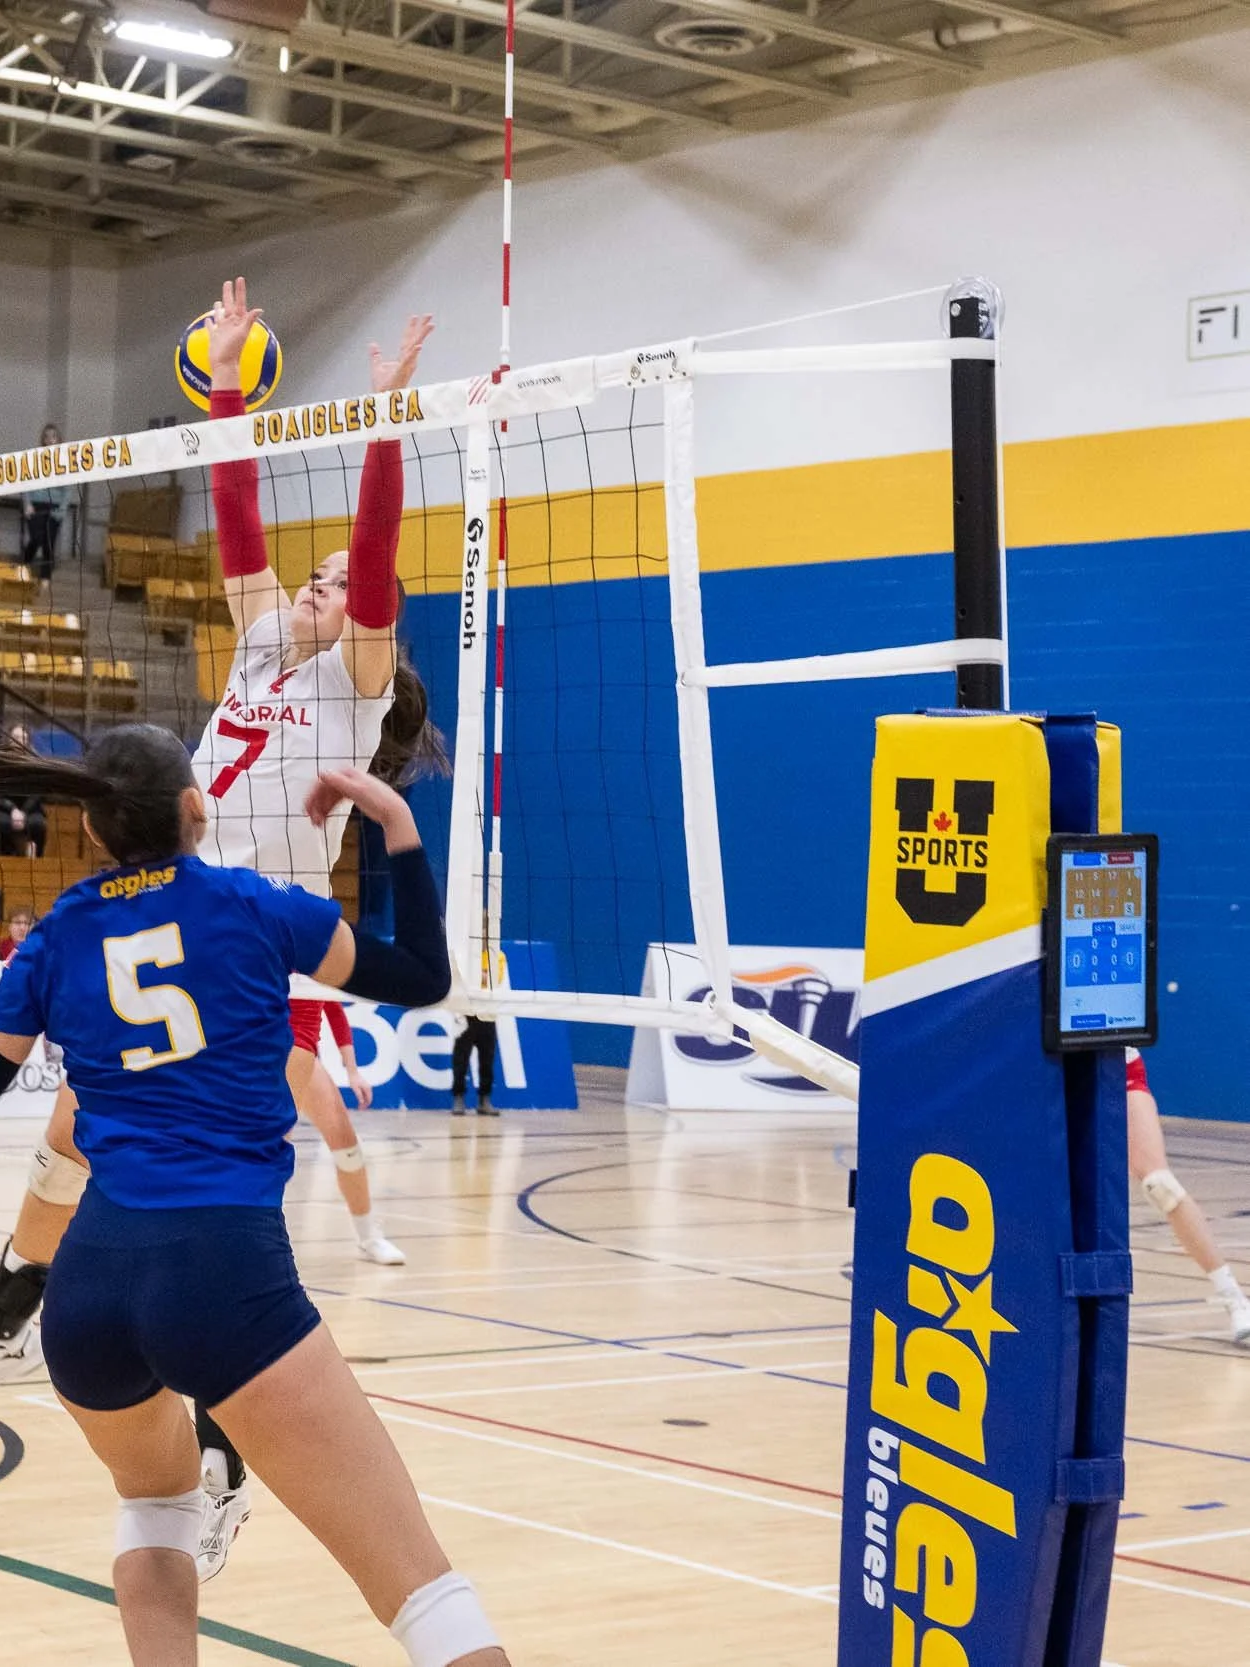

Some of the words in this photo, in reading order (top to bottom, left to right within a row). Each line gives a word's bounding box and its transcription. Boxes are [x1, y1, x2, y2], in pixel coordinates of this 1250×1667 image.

[645, 349, 677, 363] Senoh
[253, 388, 425, 447] GOAIGLES.CA
[463, 547, 480, 650] Senoh
[207, 718, 270, 800] 7
[100, 866, 177, 900] aigles
[896, 836, 989, 868] SPORTS
[103, 921, 207, 1072] 5
[863, 1426, 901, 1610] bleues
